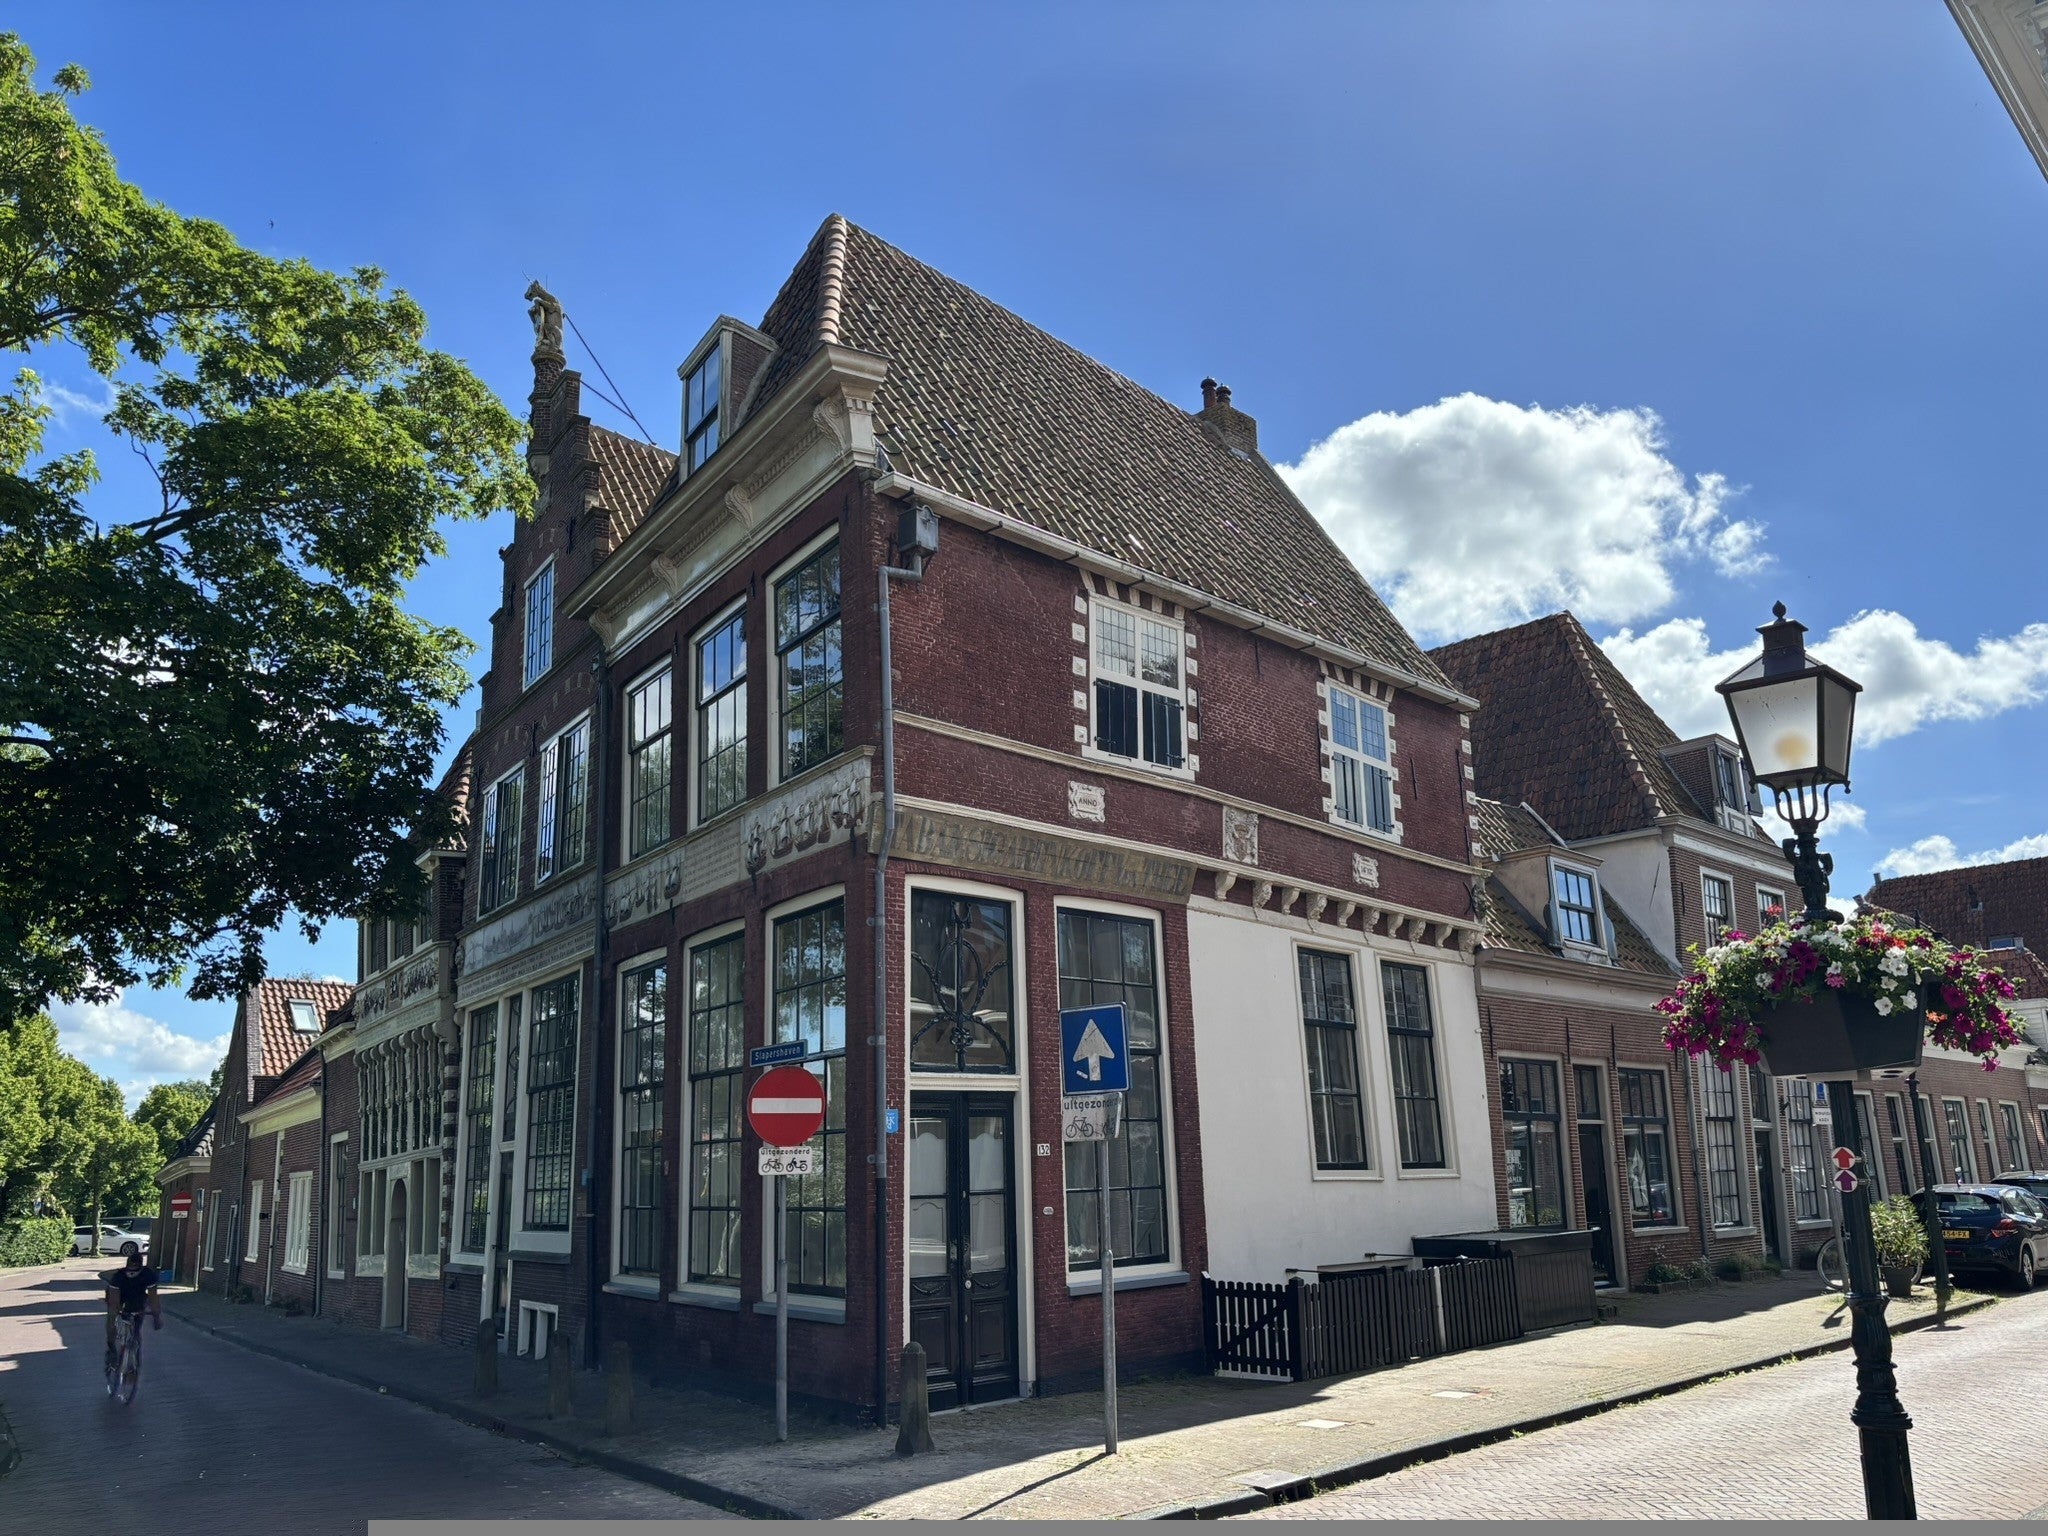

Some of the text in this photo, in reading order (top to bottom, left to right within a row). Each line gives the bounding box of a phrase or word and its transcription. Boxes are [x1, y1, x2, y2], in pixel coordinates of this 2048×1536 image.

[1078, 797, 1098, 807] ANNO
[755, 1046, 801, 1061] Slapershaven
[1038, 1144, 1050, 1155] 132
